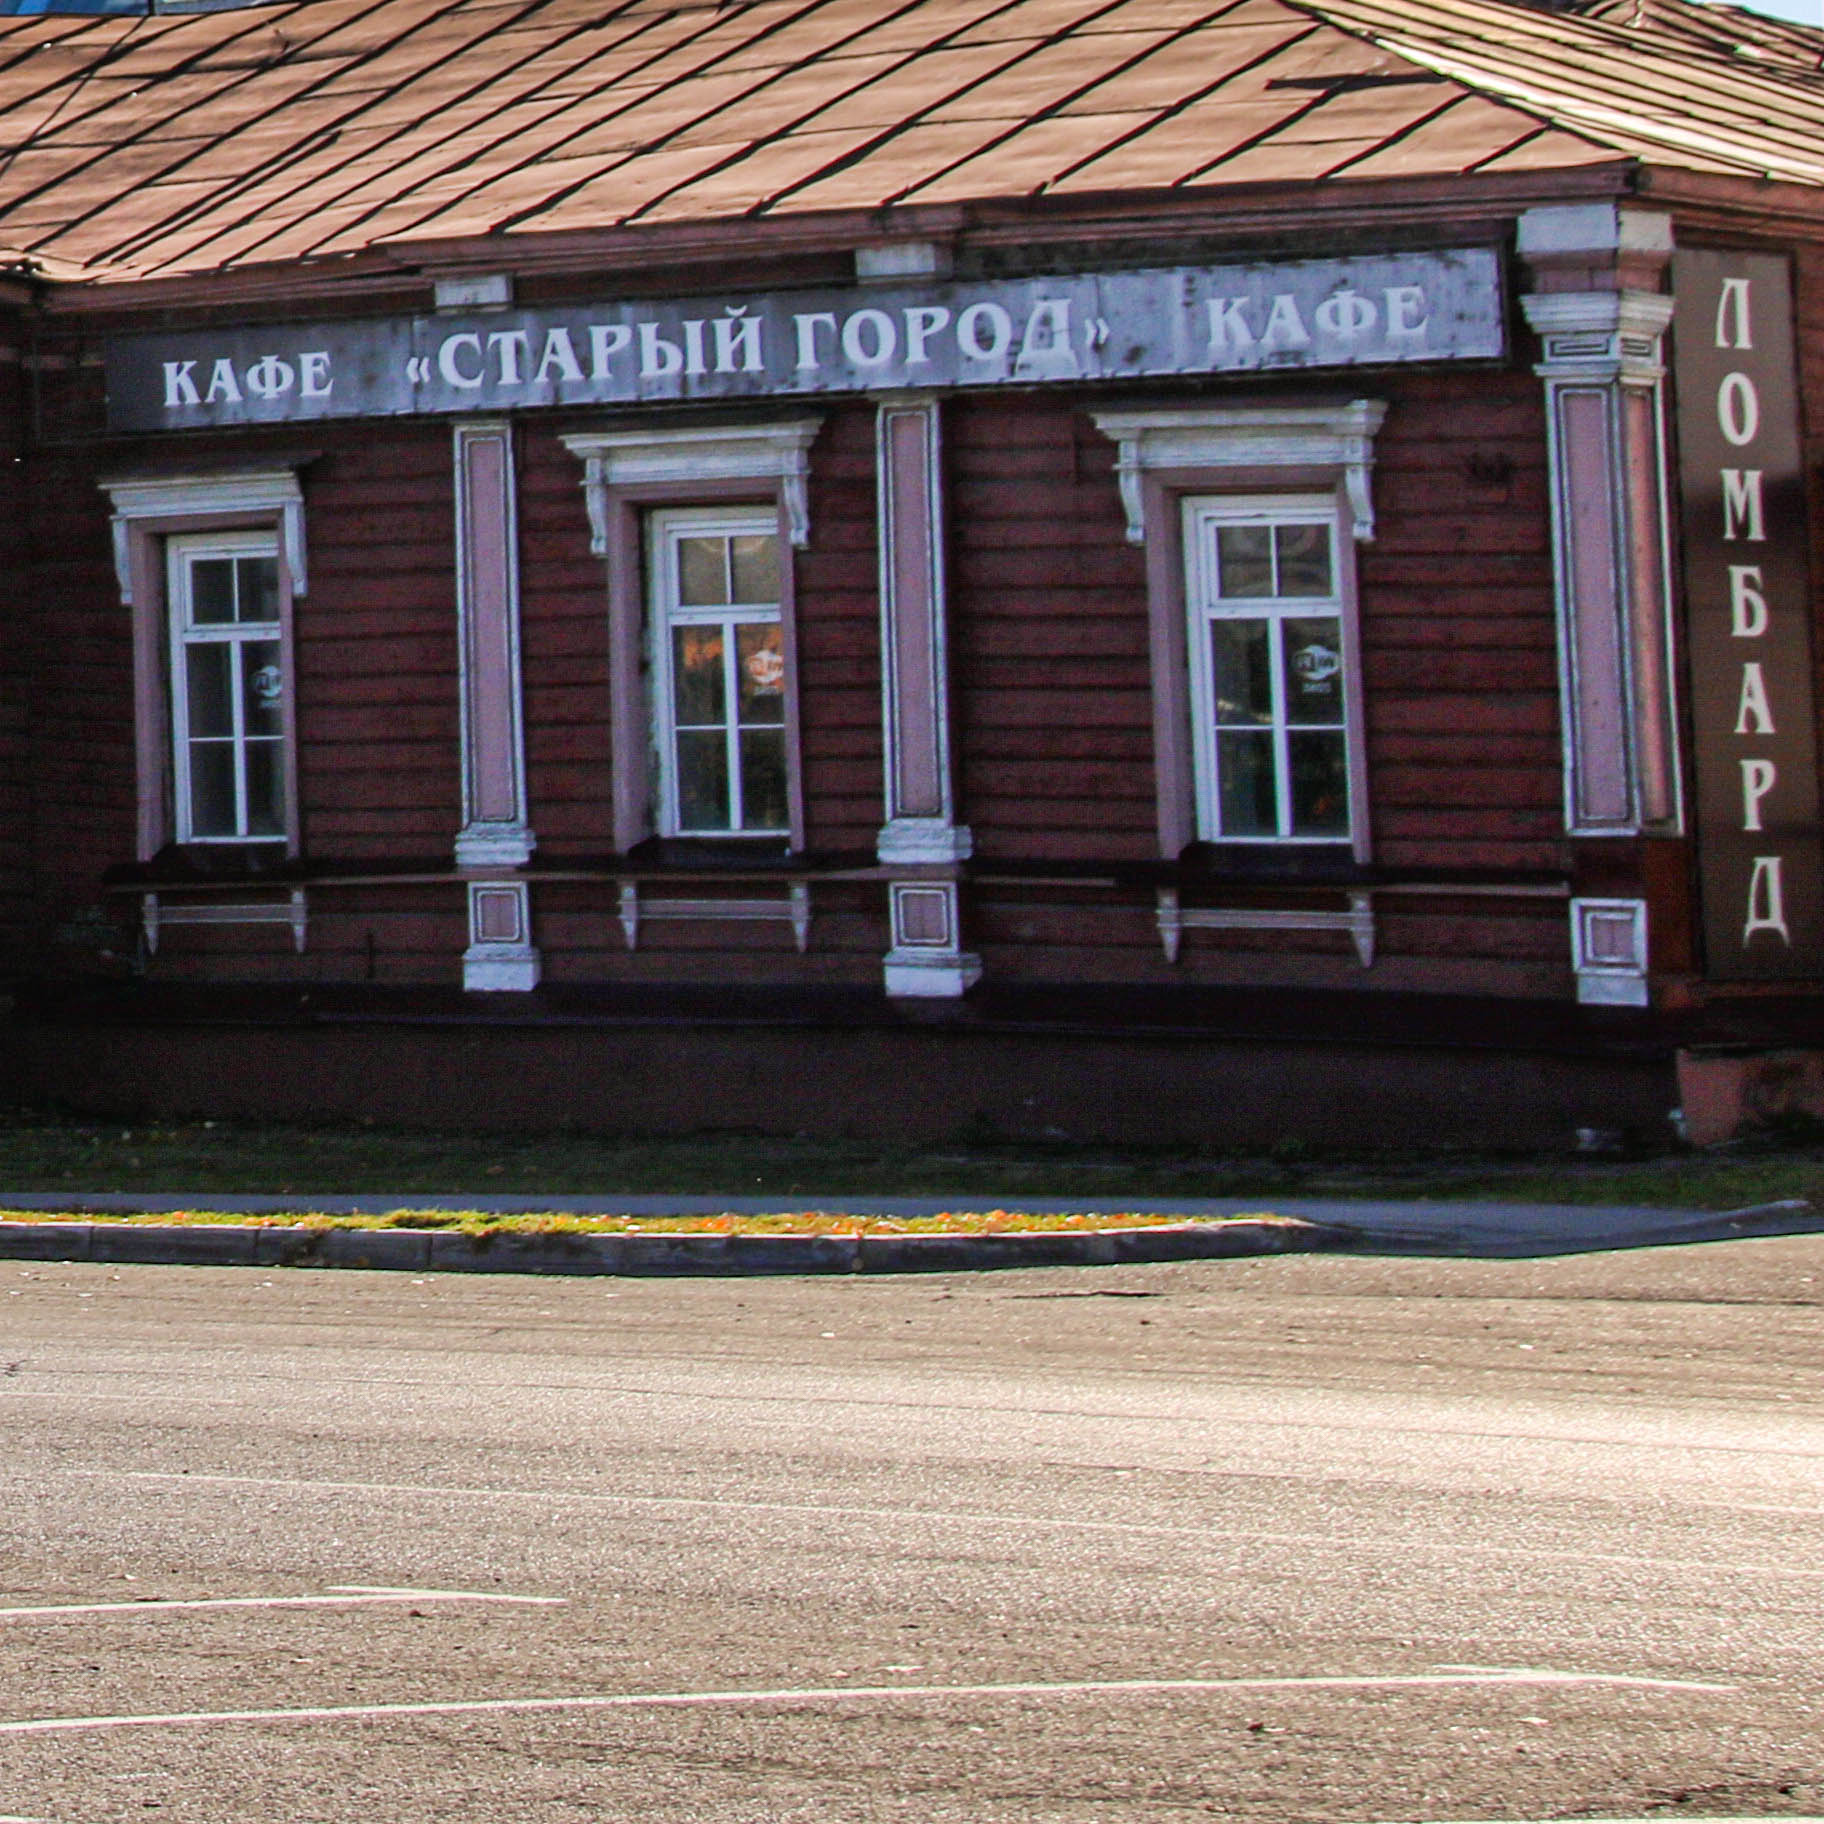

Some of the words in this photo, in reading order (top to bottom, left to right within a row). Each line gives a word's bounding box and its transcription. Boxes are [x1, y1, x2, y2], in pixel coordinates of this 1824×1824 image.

[161, 350, 335, 409] КАФЕ
[405, 303, 766, 390] «СТАРЫЙ
[792, 297, 1112, 378] ГОРОД»
[1206, 284, 1430, 350] КАФЕ
[1714, 275, 1792, 950] ЛОМБАРД
